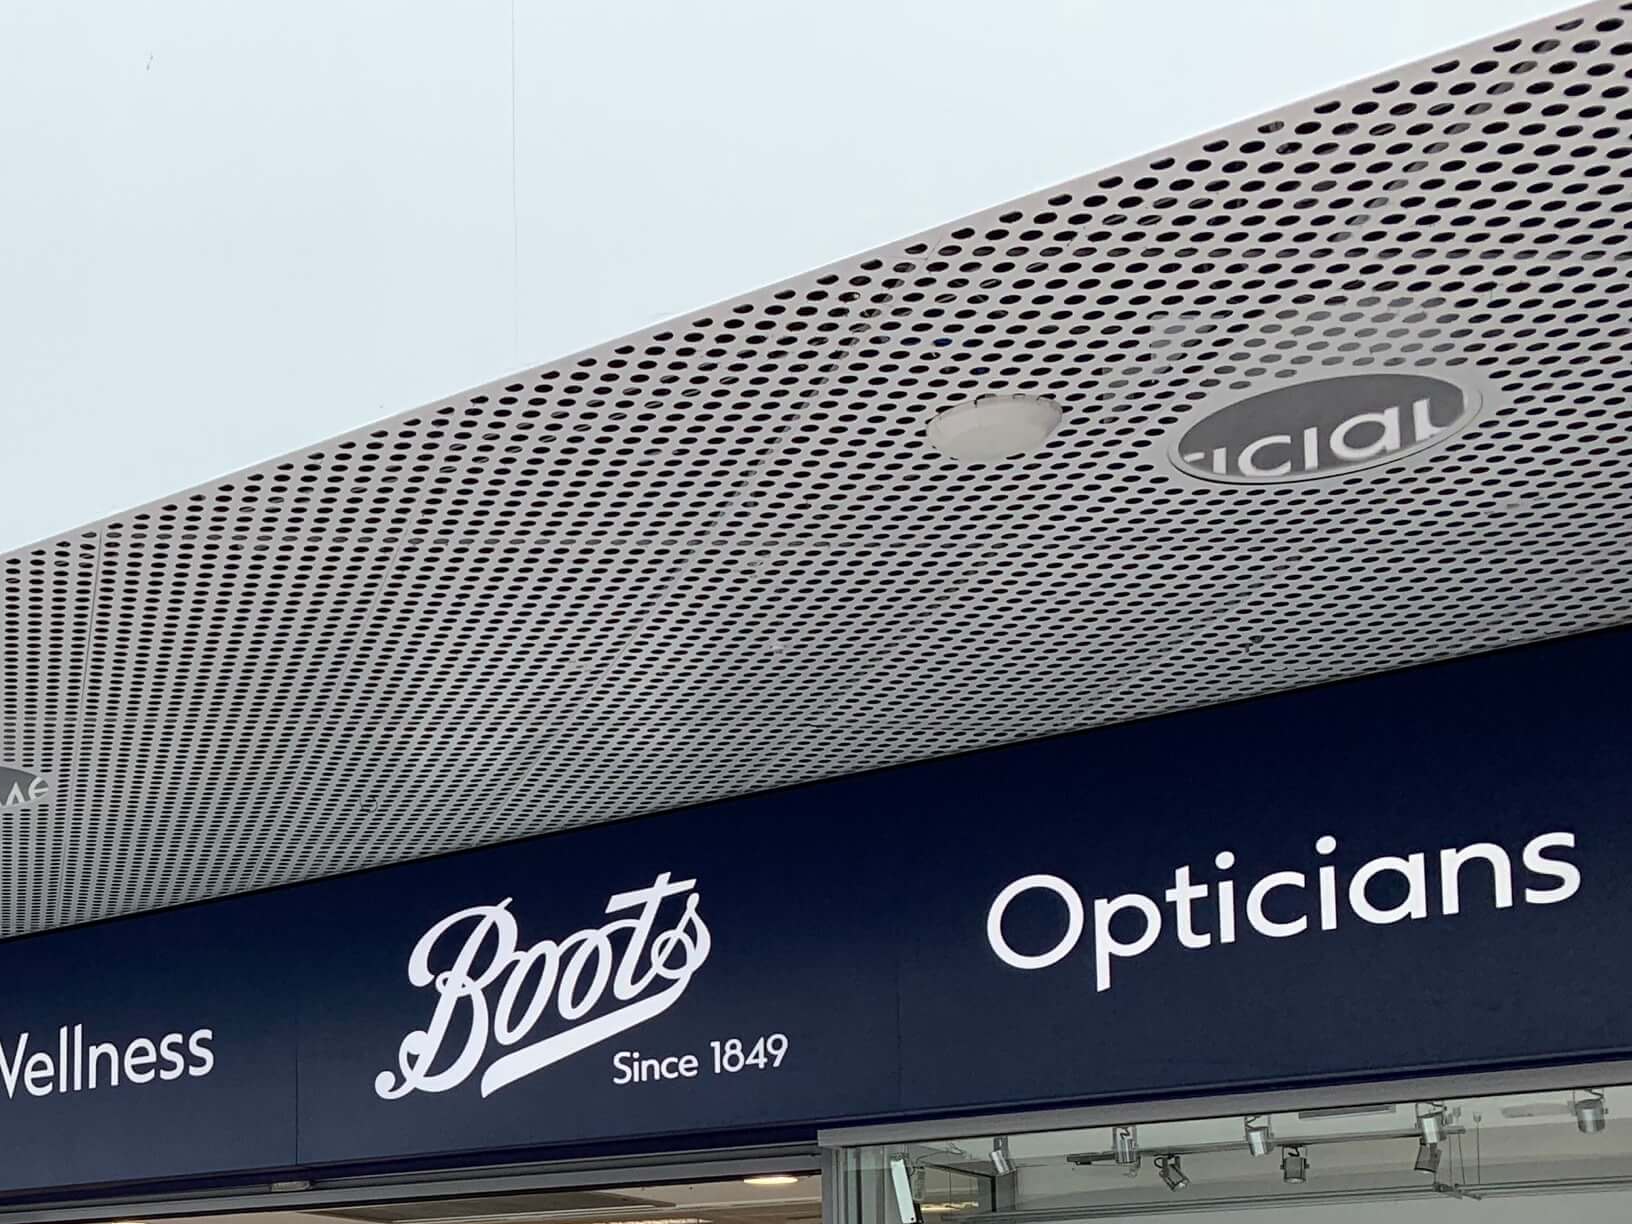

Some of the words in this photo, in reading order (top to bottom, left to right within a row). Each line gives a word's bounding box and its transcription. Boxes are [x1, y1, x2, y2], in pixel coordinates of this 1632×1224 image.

[375, 872, 711, 1099] Boots
[987, 832, 1581, 992] Opticians
[613, 1051, 698, 1085] Since
[710, 1033, 788, 1075] 1849
